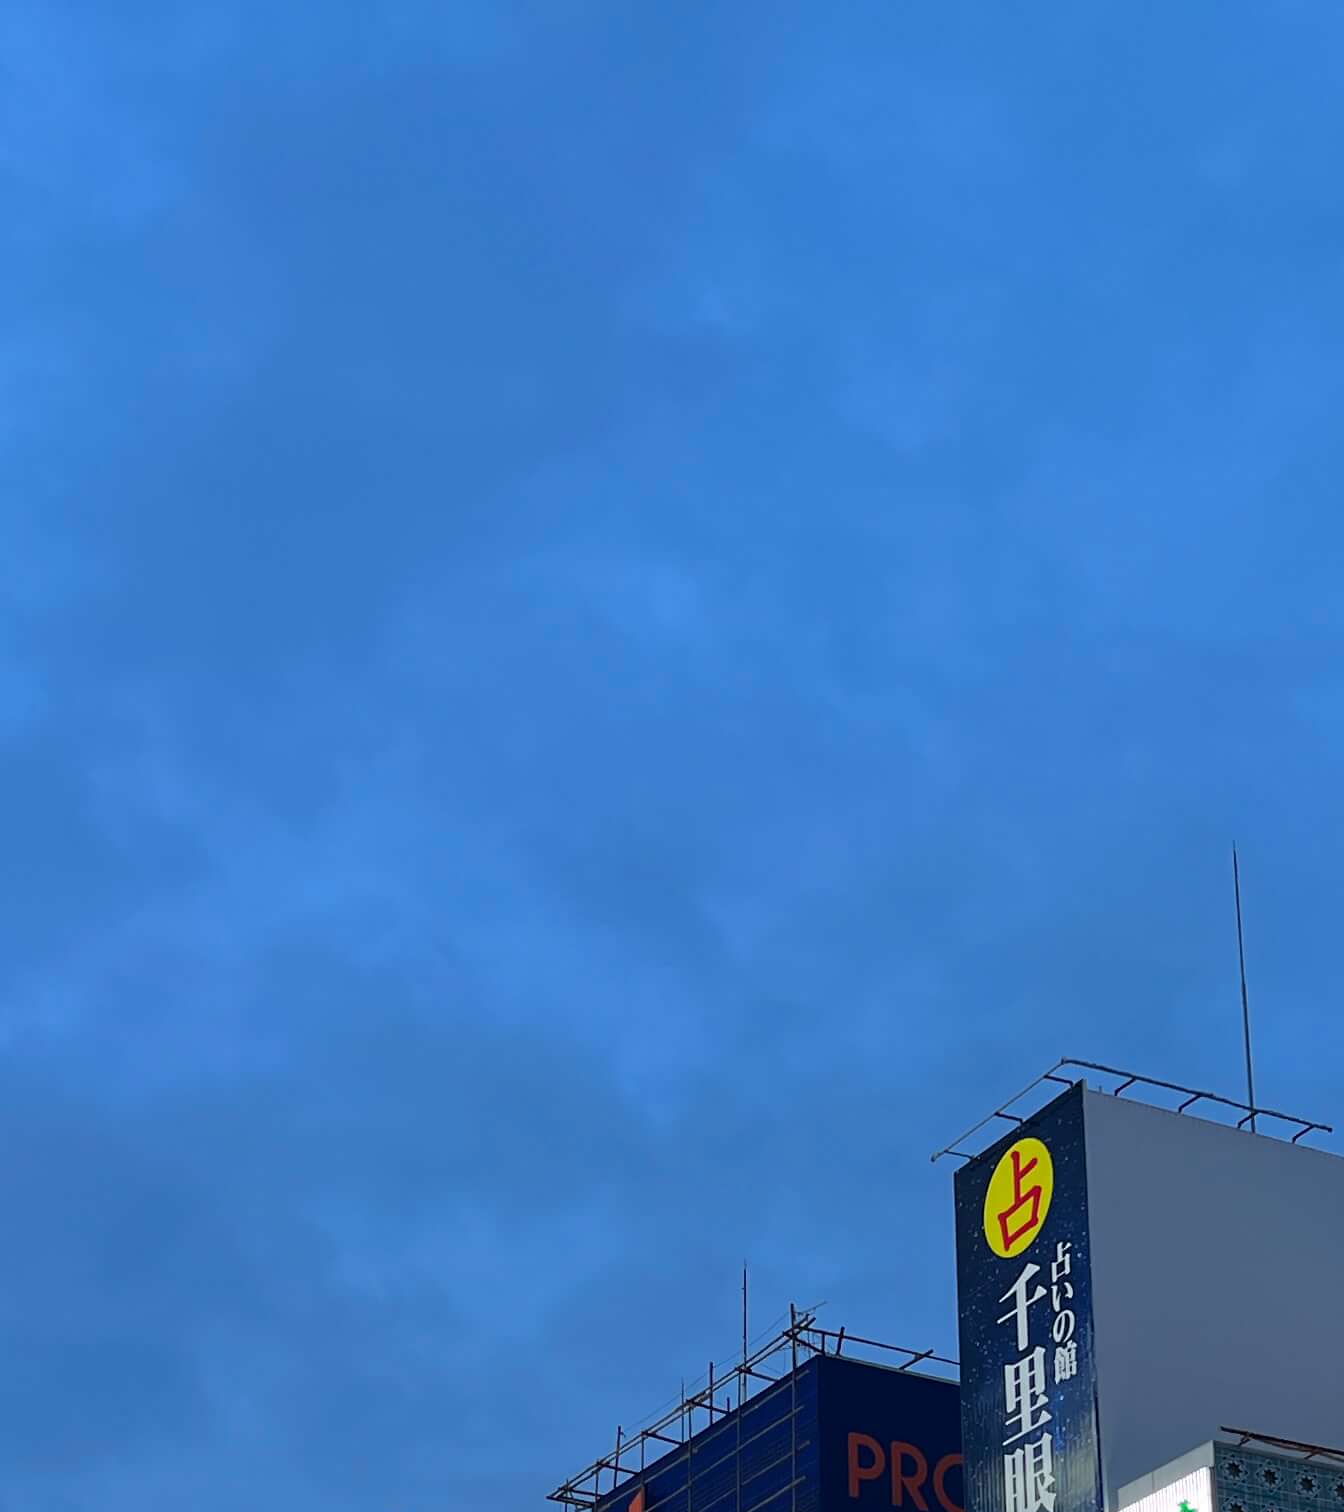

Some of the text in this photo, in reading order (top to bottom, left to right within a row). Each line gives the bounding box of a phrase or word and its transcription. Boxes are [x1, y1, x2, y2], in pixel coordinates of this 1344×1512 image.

[998, 1150, 1042, 1251] 占
[1050, 1241, 1077, 1384] 占いの館
